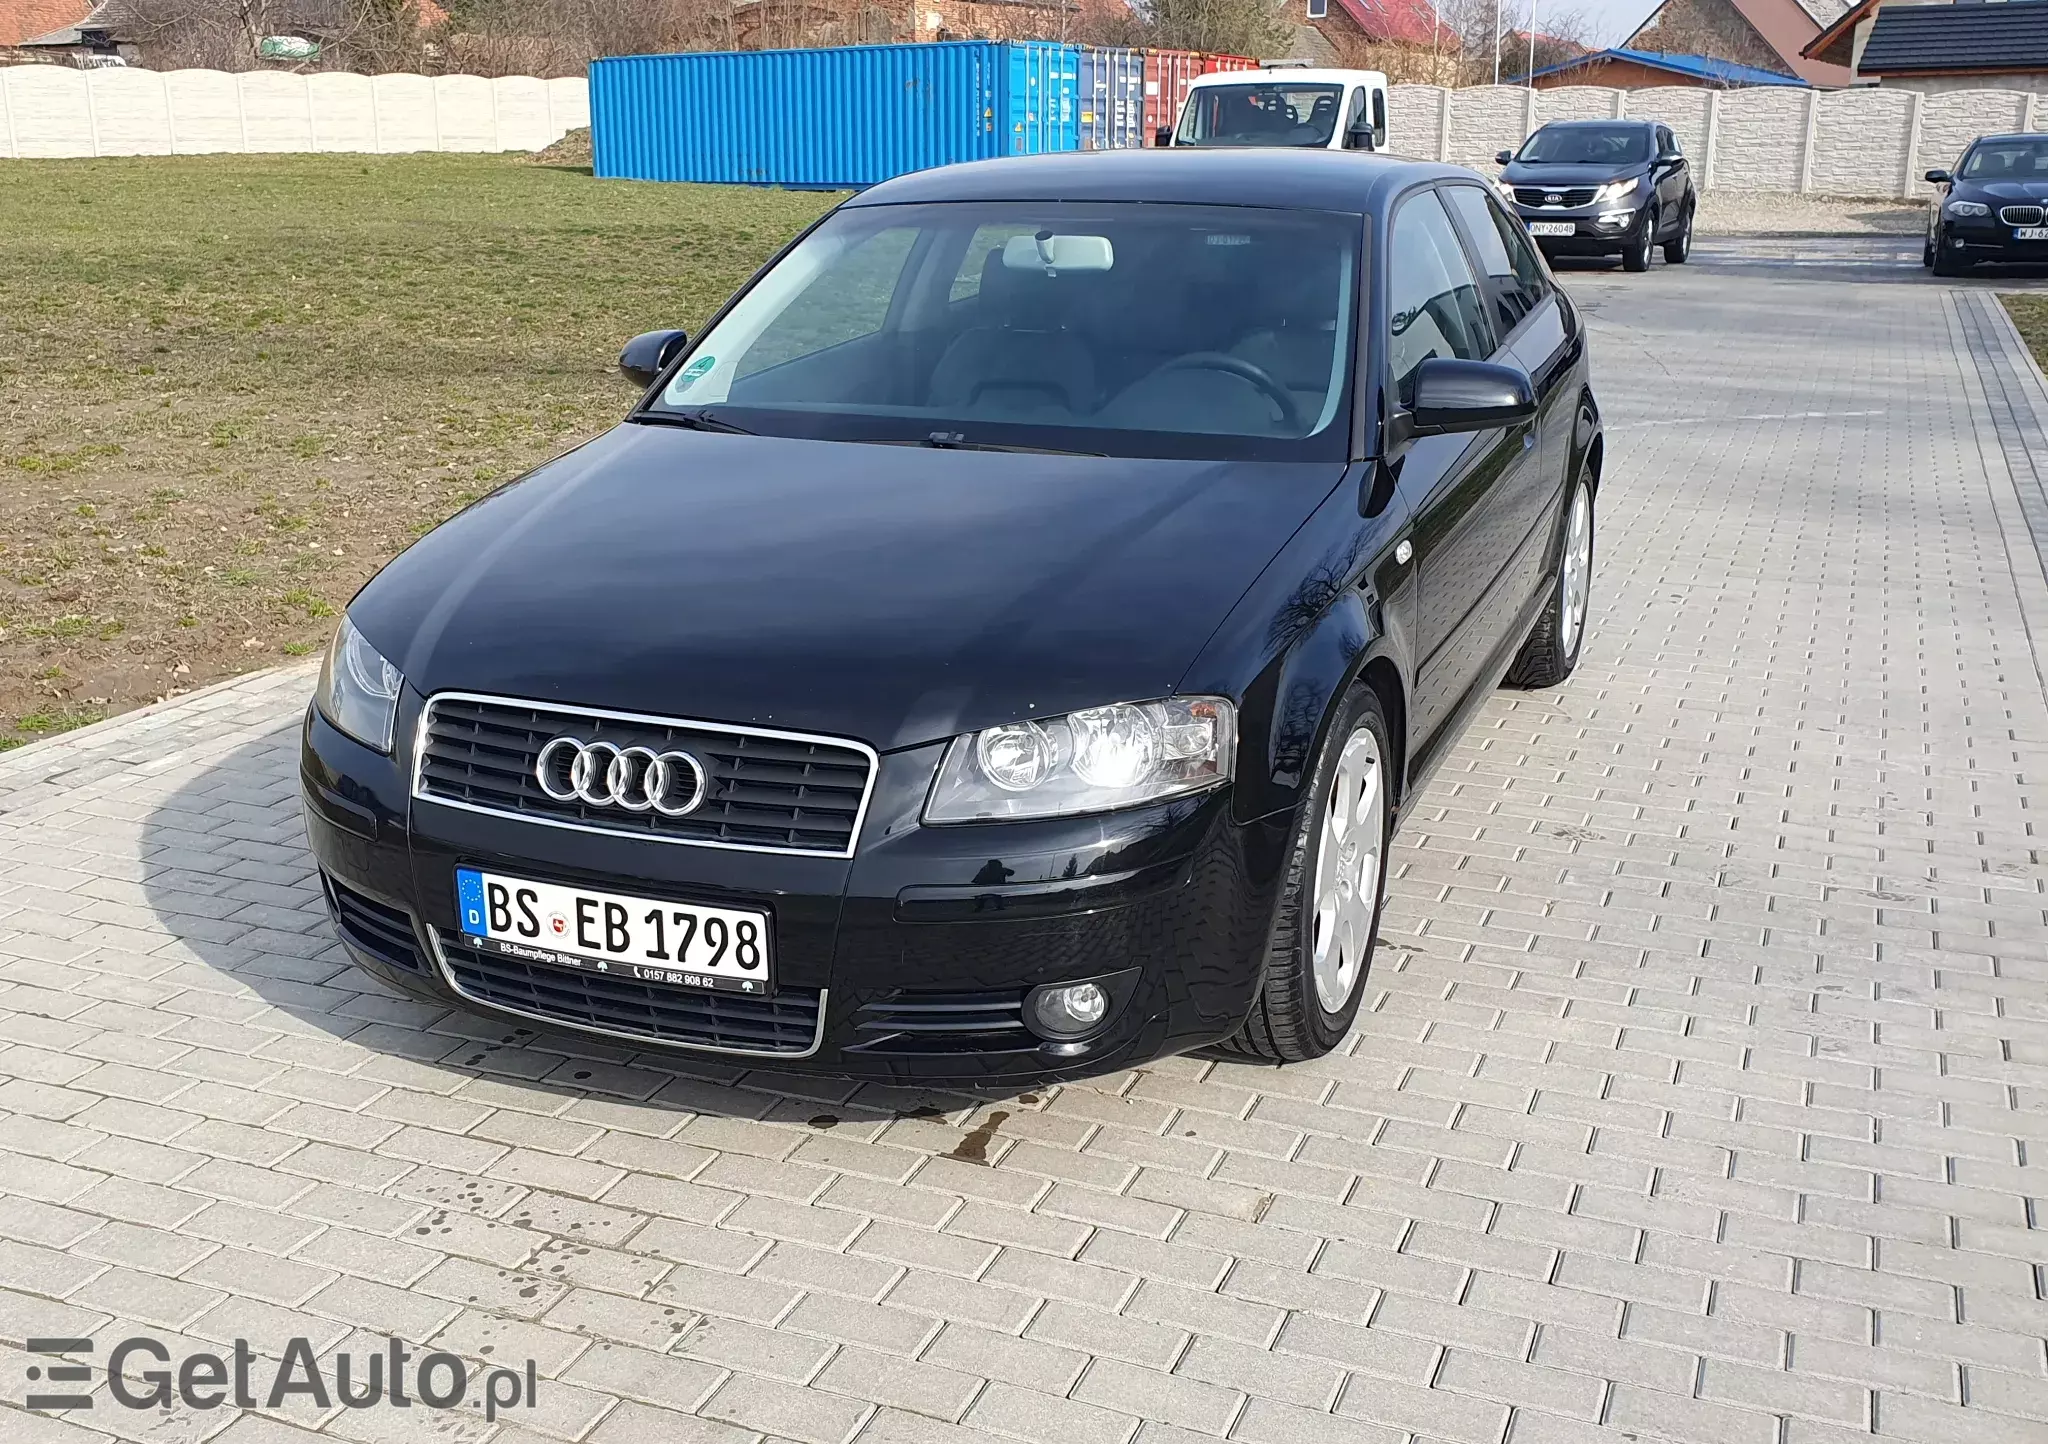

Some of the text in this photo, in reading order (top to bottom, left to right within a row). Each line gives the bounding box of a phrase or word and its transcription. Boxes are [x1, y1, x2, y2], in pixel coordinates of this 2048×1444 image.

[1548, 224, 1574, 233] 26048
[2020, 229, 2034, 238] WJ
[468, 909, 480, 925] D
[488, 882, 760, 970] BS EB 1798
[500, 943, 582, 967] BS-Baumpflege Bittner
[644, 968, 714, 988] 0157 882 908 62
